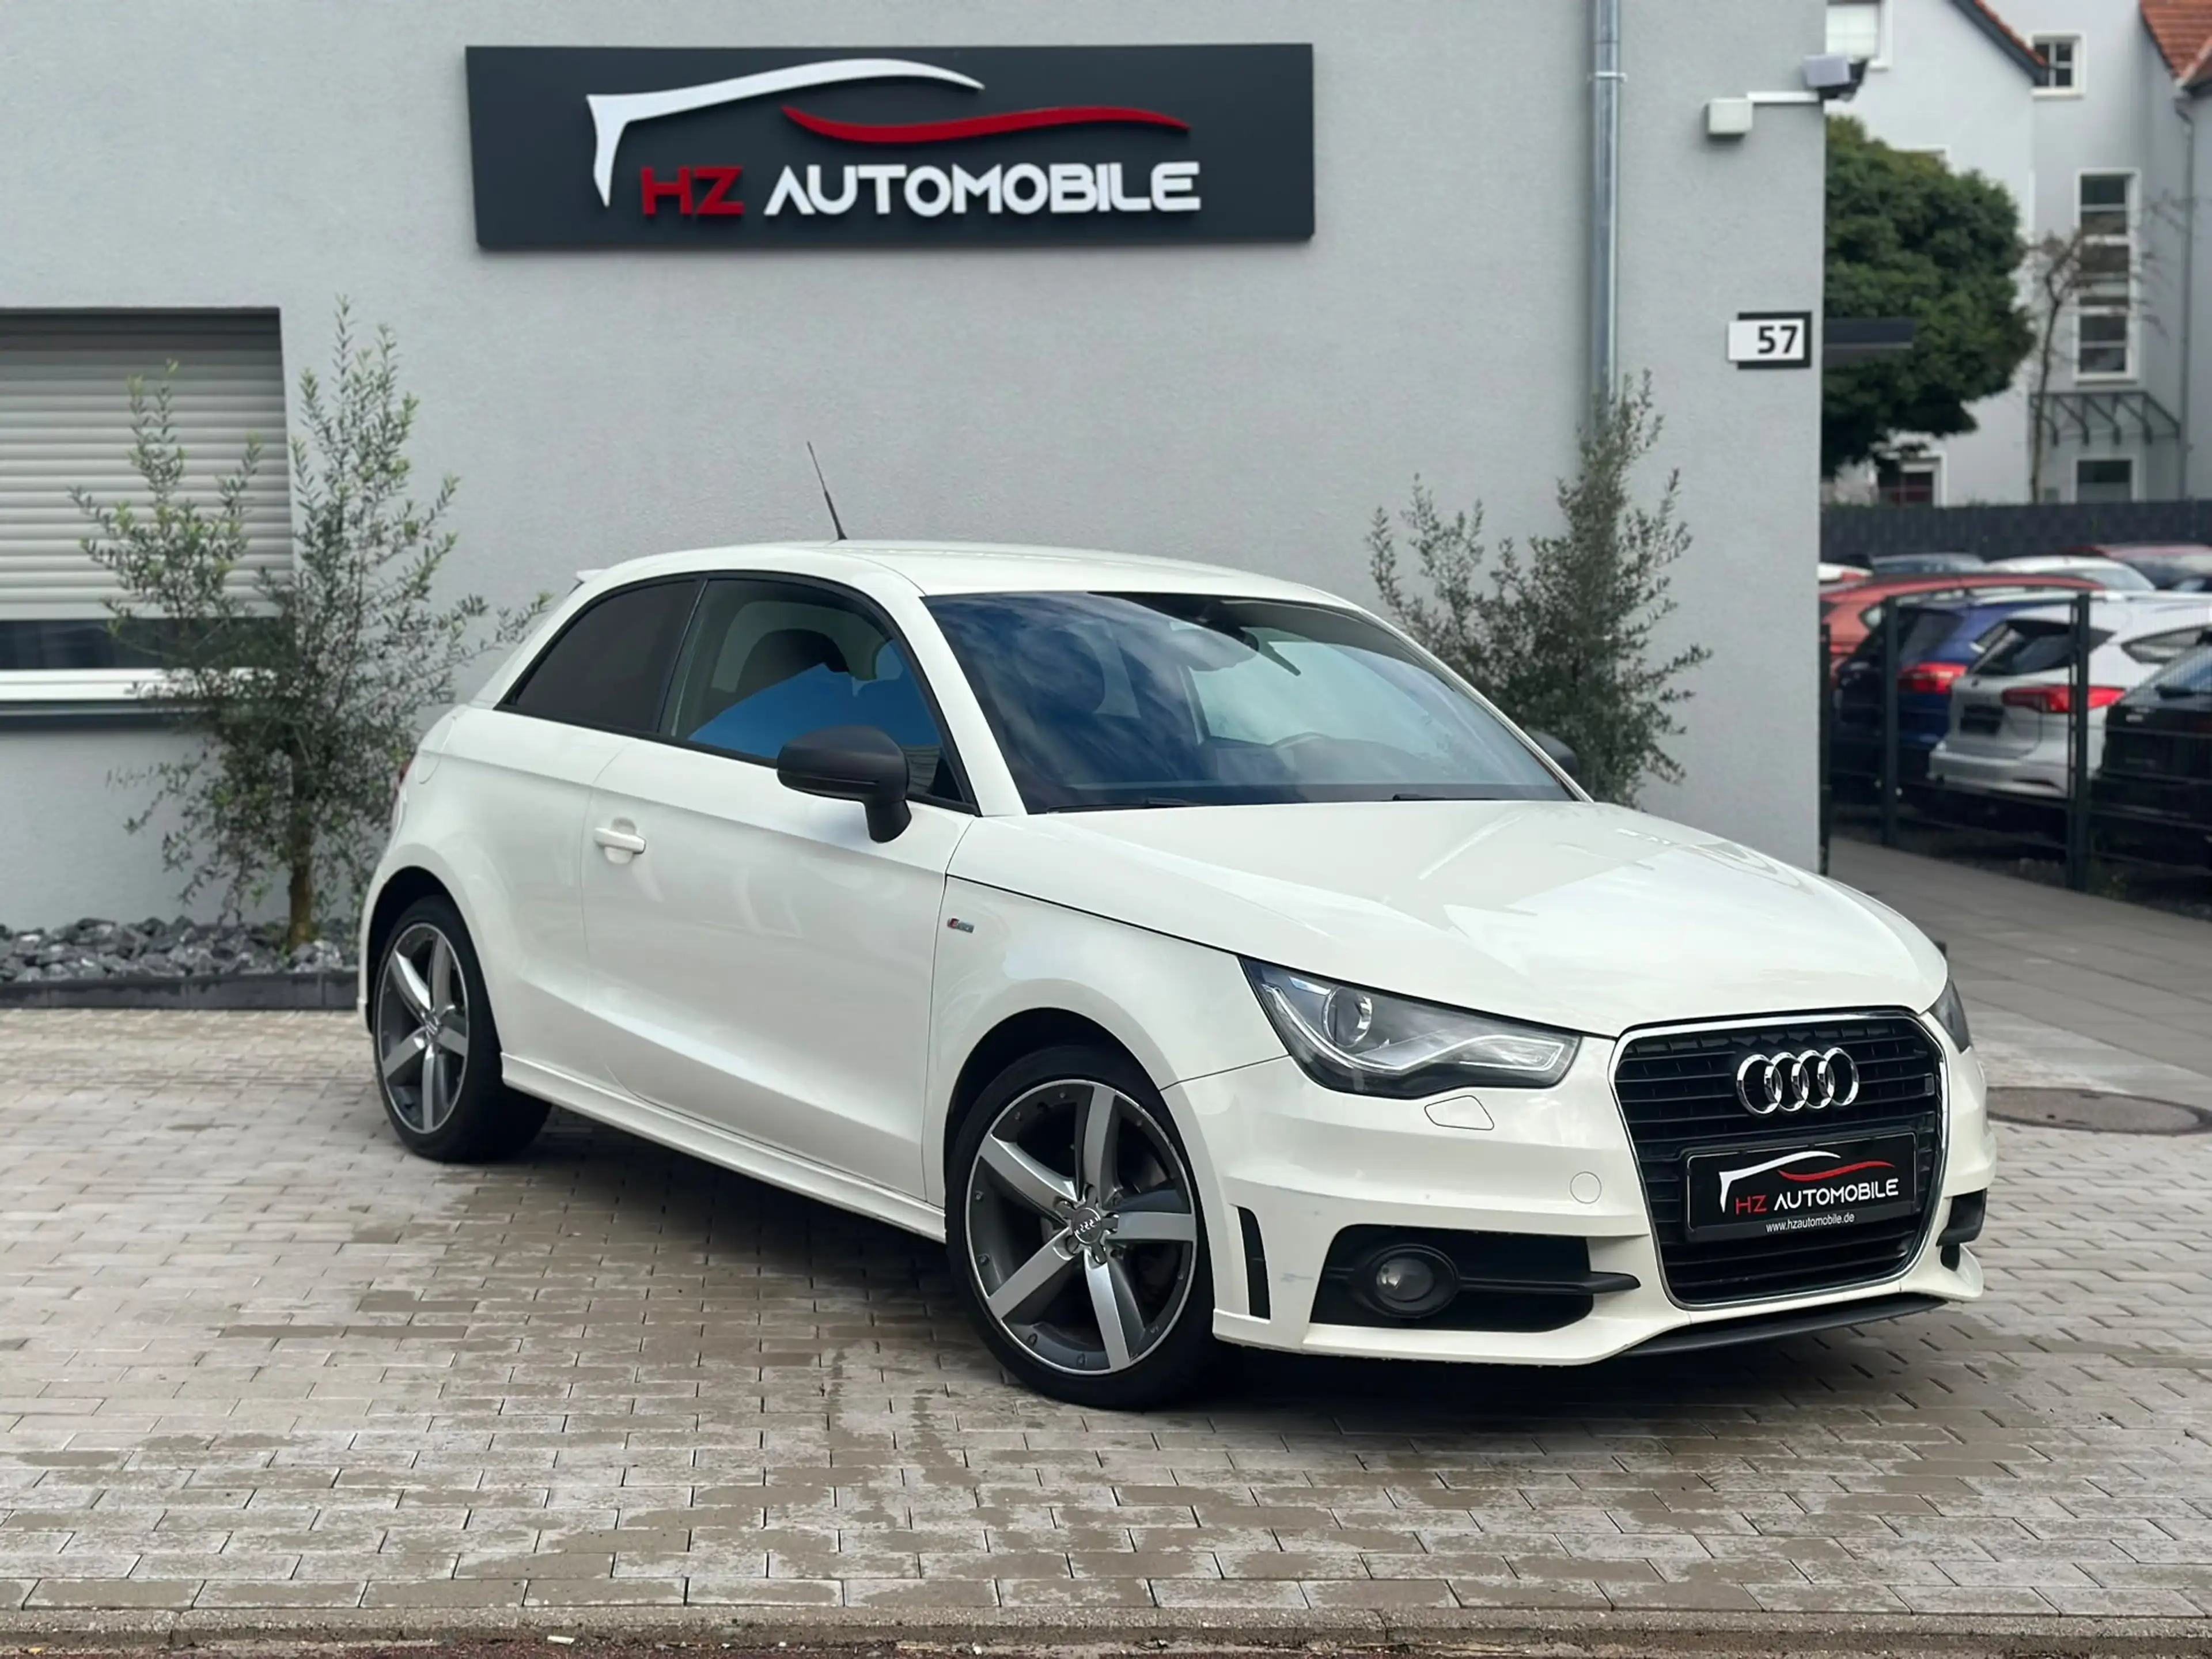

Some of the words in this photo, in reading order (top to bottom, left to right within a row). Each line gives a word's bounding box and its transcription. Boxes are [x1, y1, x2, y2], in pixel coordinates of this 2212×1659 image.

[641, 165, 744, 215] HZ
[764, 161, 1201, 217] AUTOMOBILE
[1757, 325, 1798, 354] 57
[1735, 1195, 1767, 1214] HZ
[1774, 1178, 1899, 1211] AUTOMOBILE
[1766, 1212, 1855, 1233] www.hzautomobile.de
